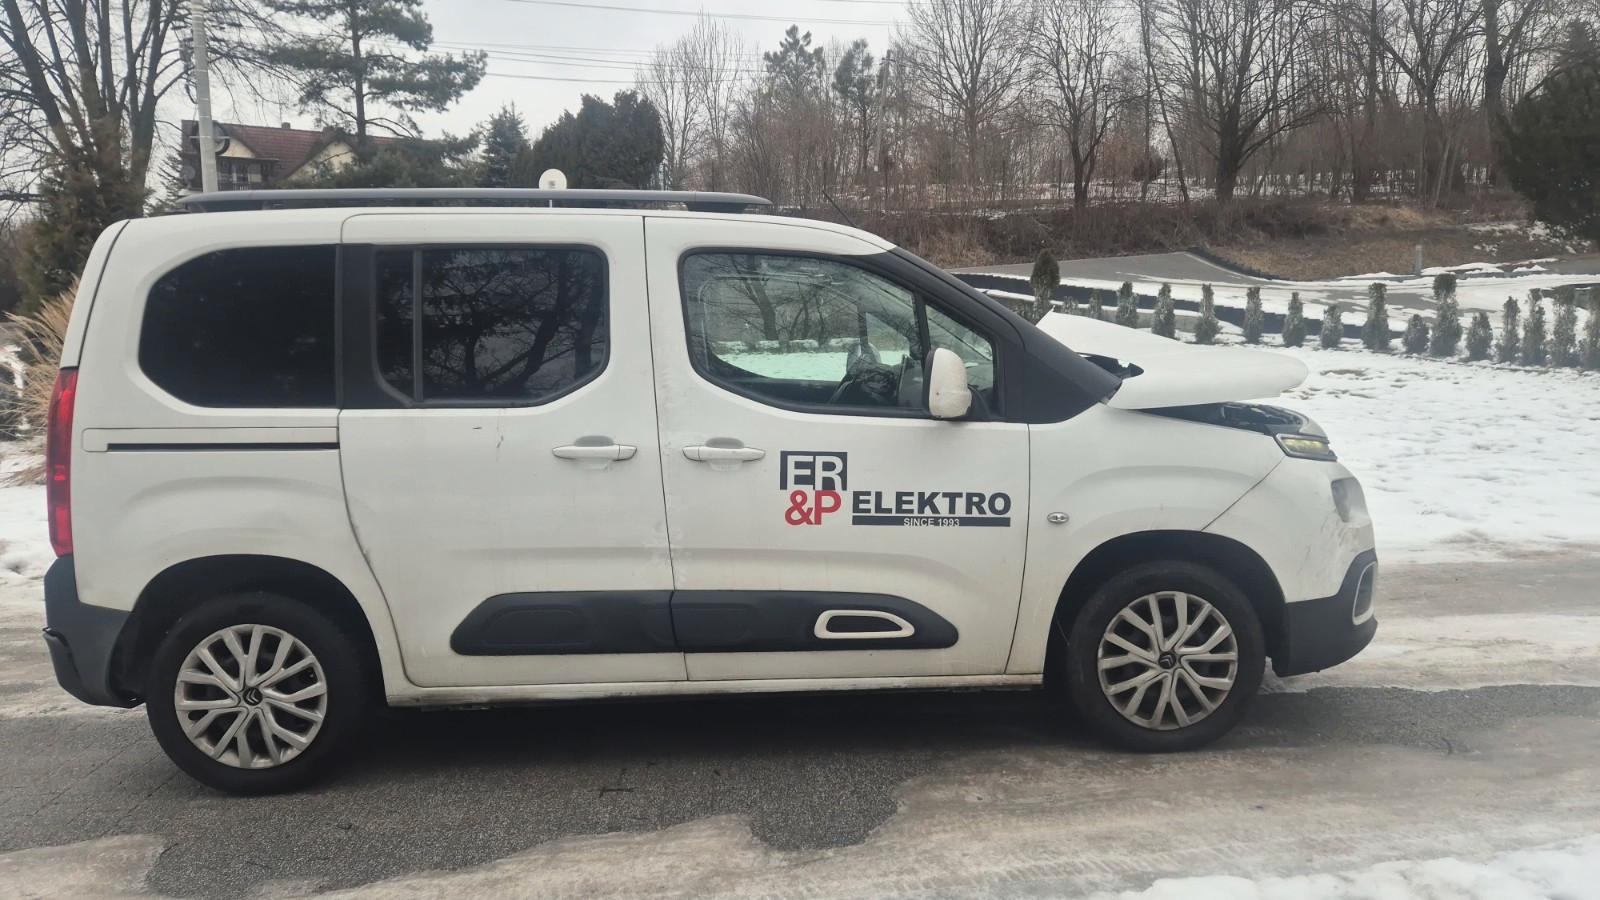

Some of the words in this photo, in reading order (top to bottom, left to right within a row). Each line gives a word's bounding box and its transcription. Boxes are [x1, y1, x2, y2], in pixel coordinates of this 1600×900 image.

[786, 454, 844, 490] ER
[784, 489, 842, 525] &P
[852, 490, 1012, 515] ELEKTRO
[903, 517, 934, 527] SINCE
[936, 518, 960, 527] 1993
